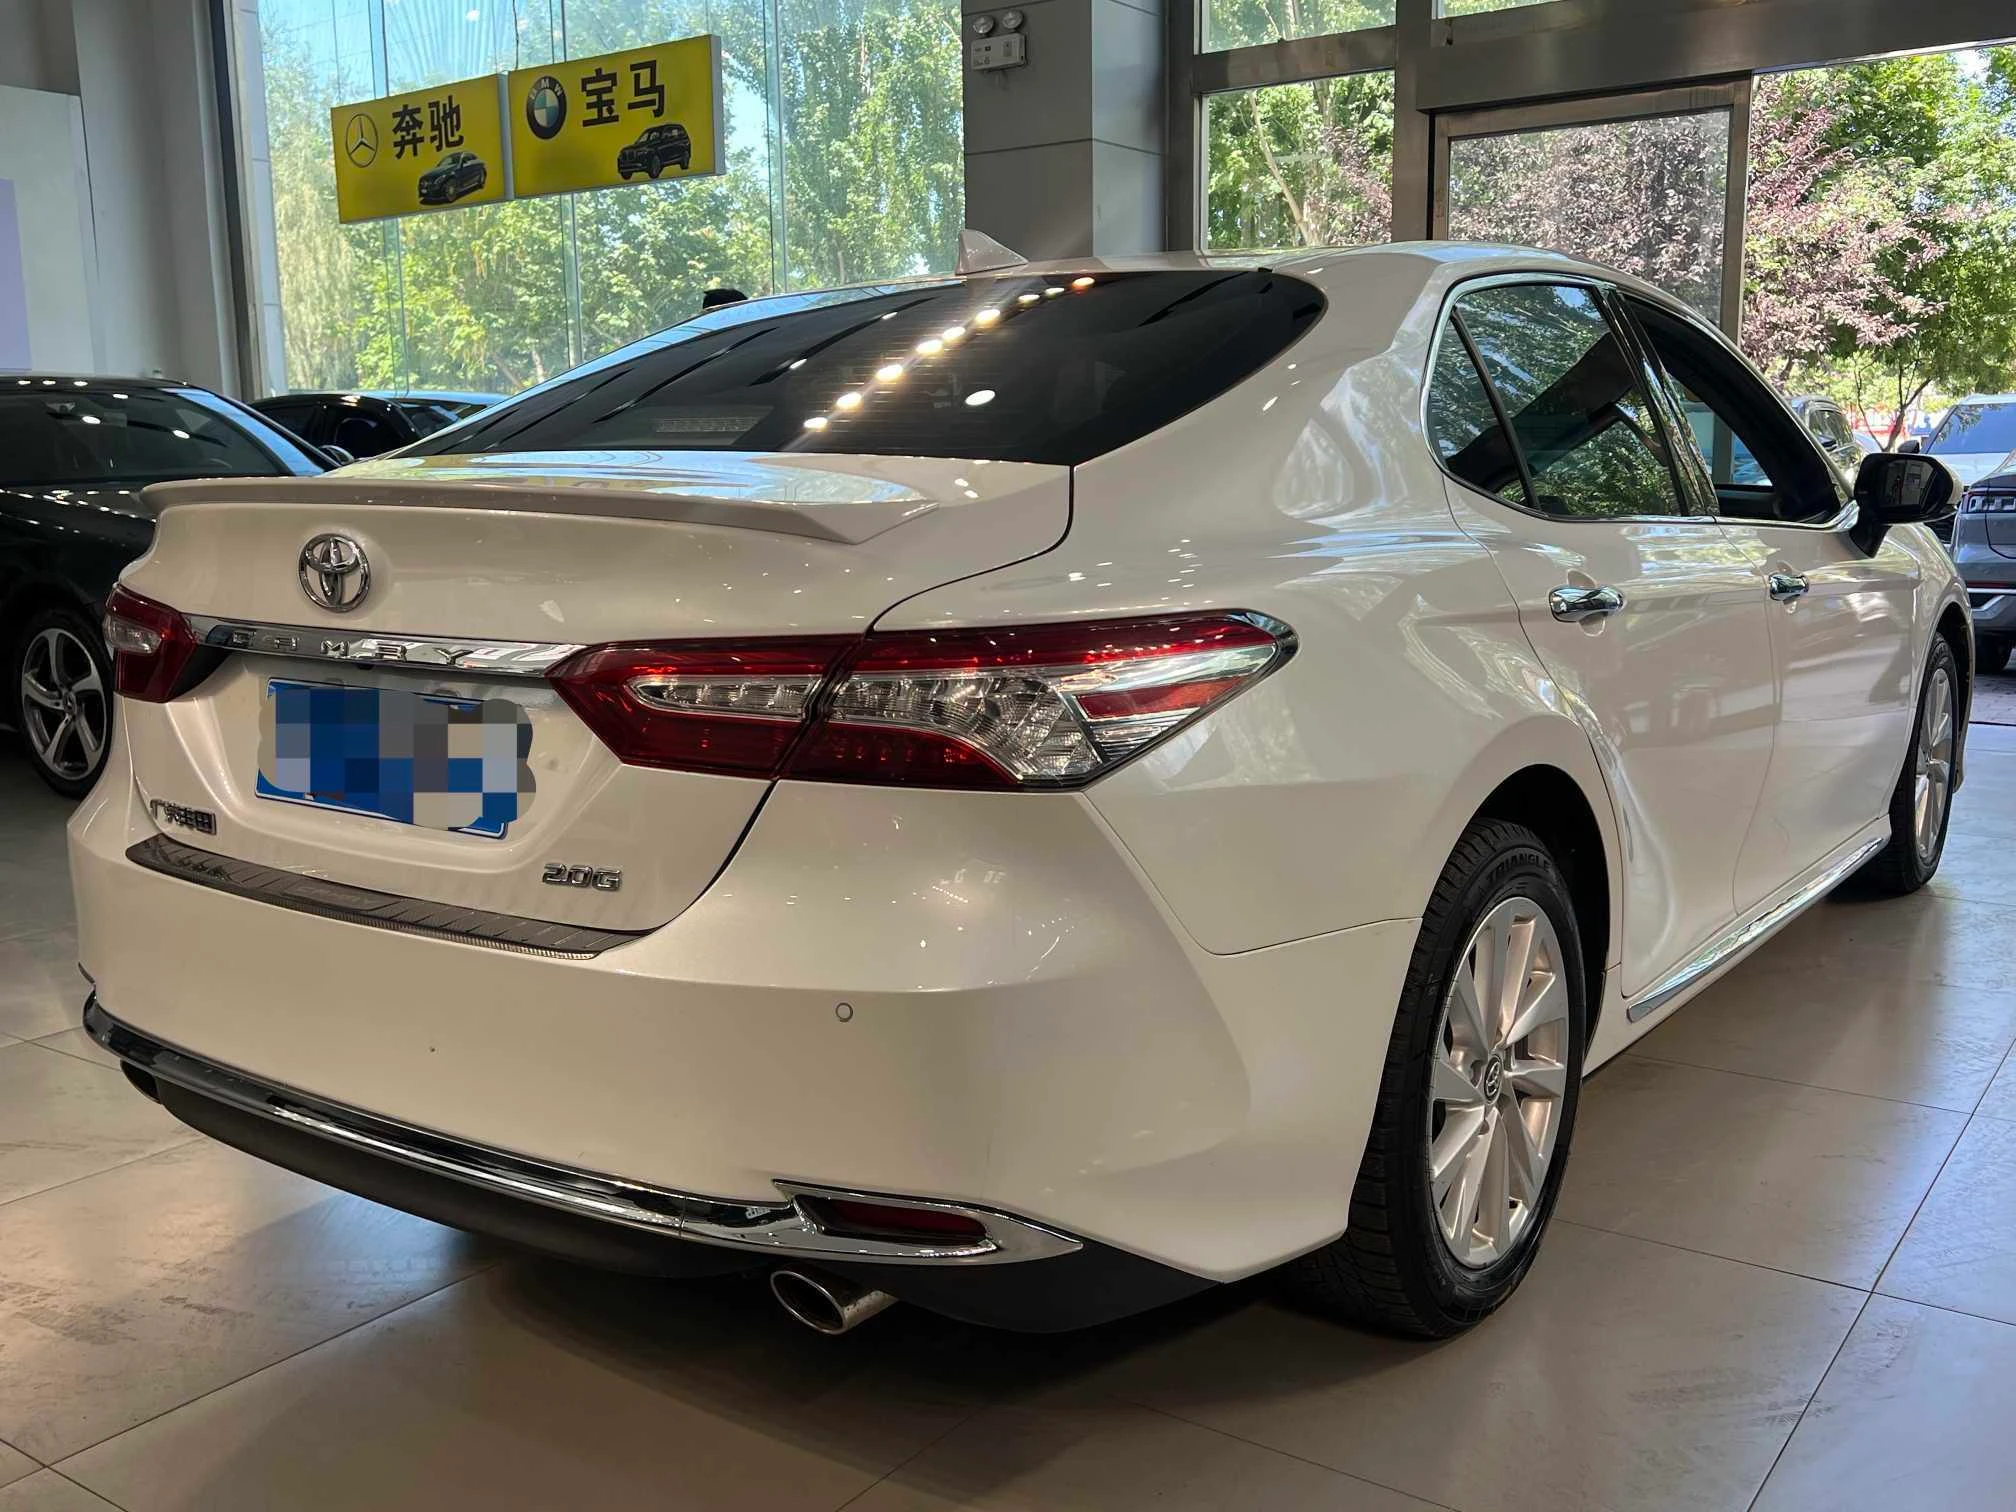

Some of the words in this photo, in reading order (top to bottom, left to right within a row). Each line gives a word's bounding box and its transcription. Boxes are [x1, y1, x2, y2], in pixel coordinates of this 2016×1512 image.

[580, 60, 665, 127] 宝马
[392, 95, 464, 159] 奔驰
[1489, 854, 1551, 882] TRIANGLE
